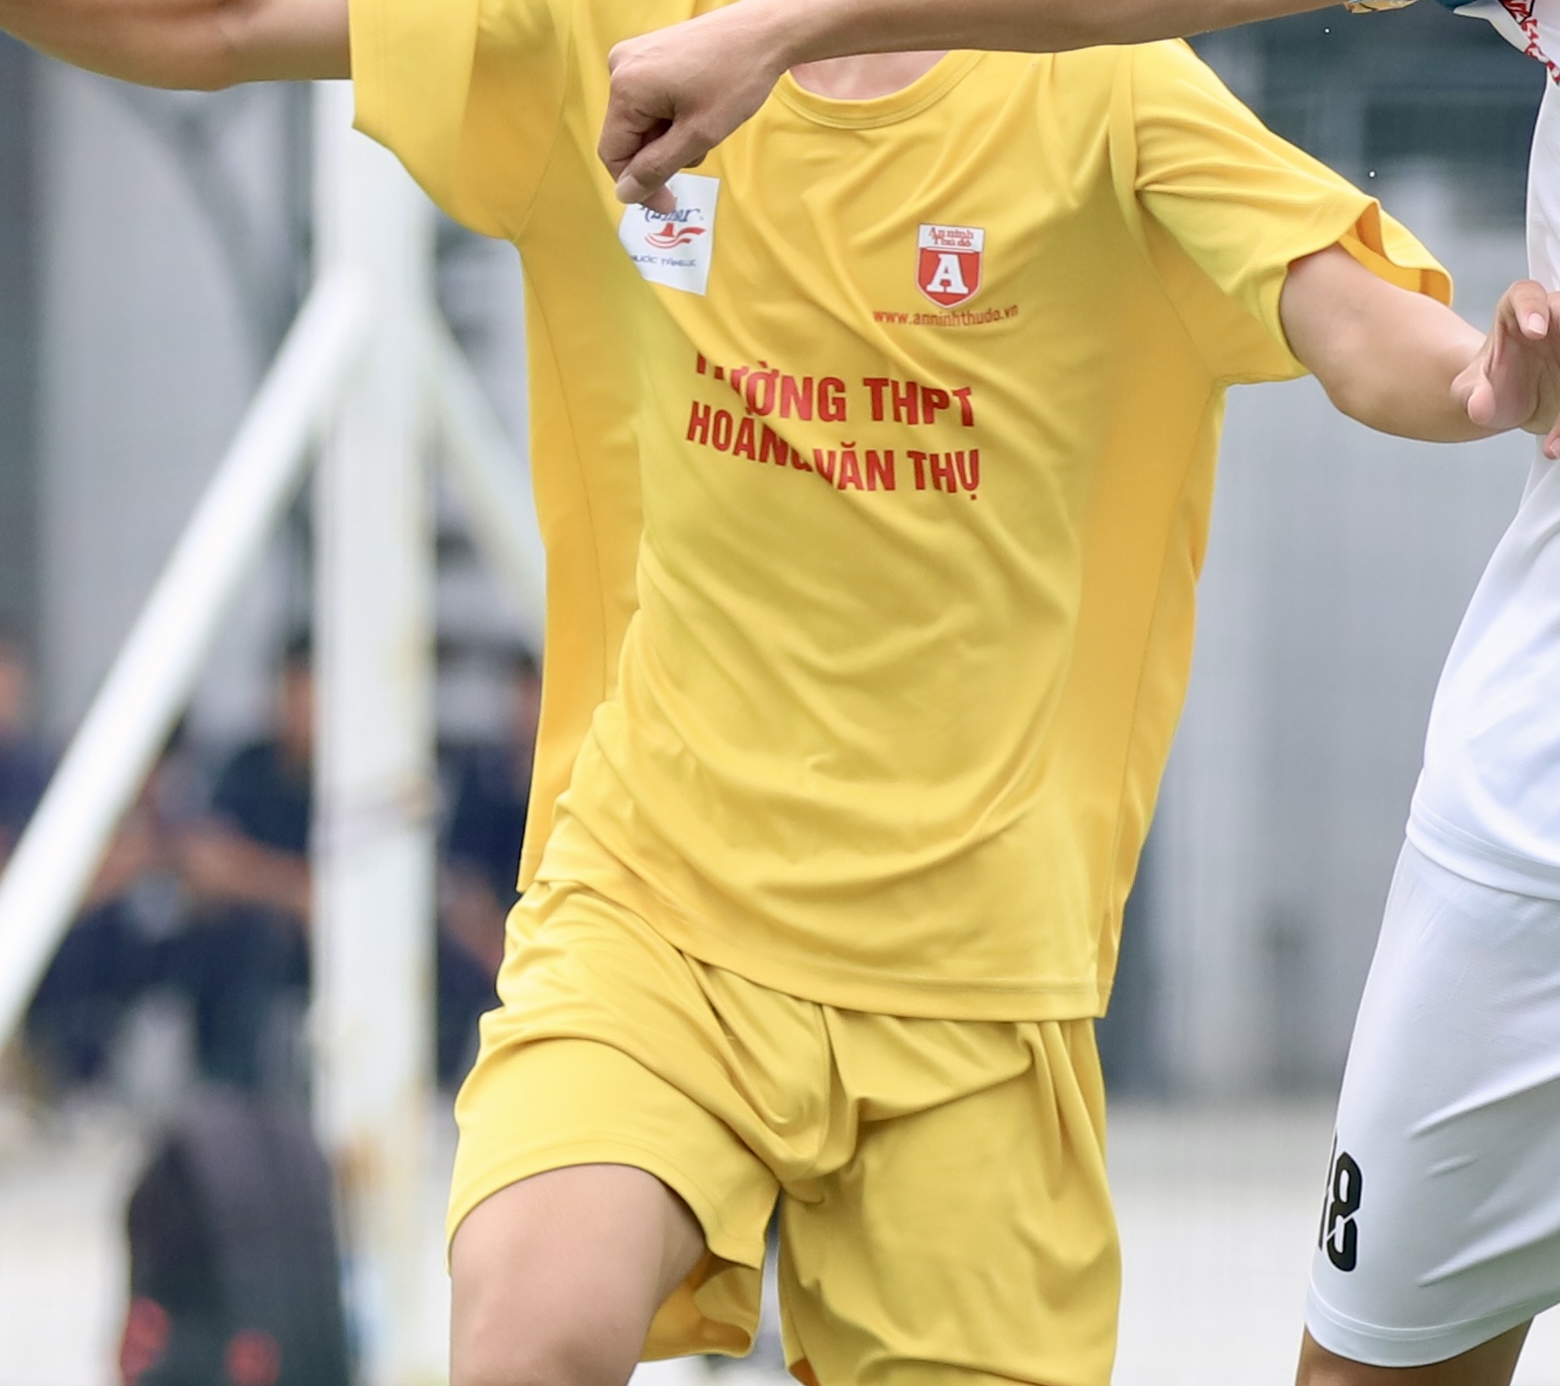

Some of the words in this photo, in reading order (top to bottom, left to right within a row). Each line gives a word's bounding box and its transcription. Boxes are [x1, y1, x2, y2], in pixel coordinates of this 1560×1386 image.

[926, 253, 969, 294] A
[863, 377, 974, 427] THPT
[812, 440, 896, 492] VĂN
[906, 449, 980, 500] THỤ
[1318, 1130, 1363, 1273] 8
